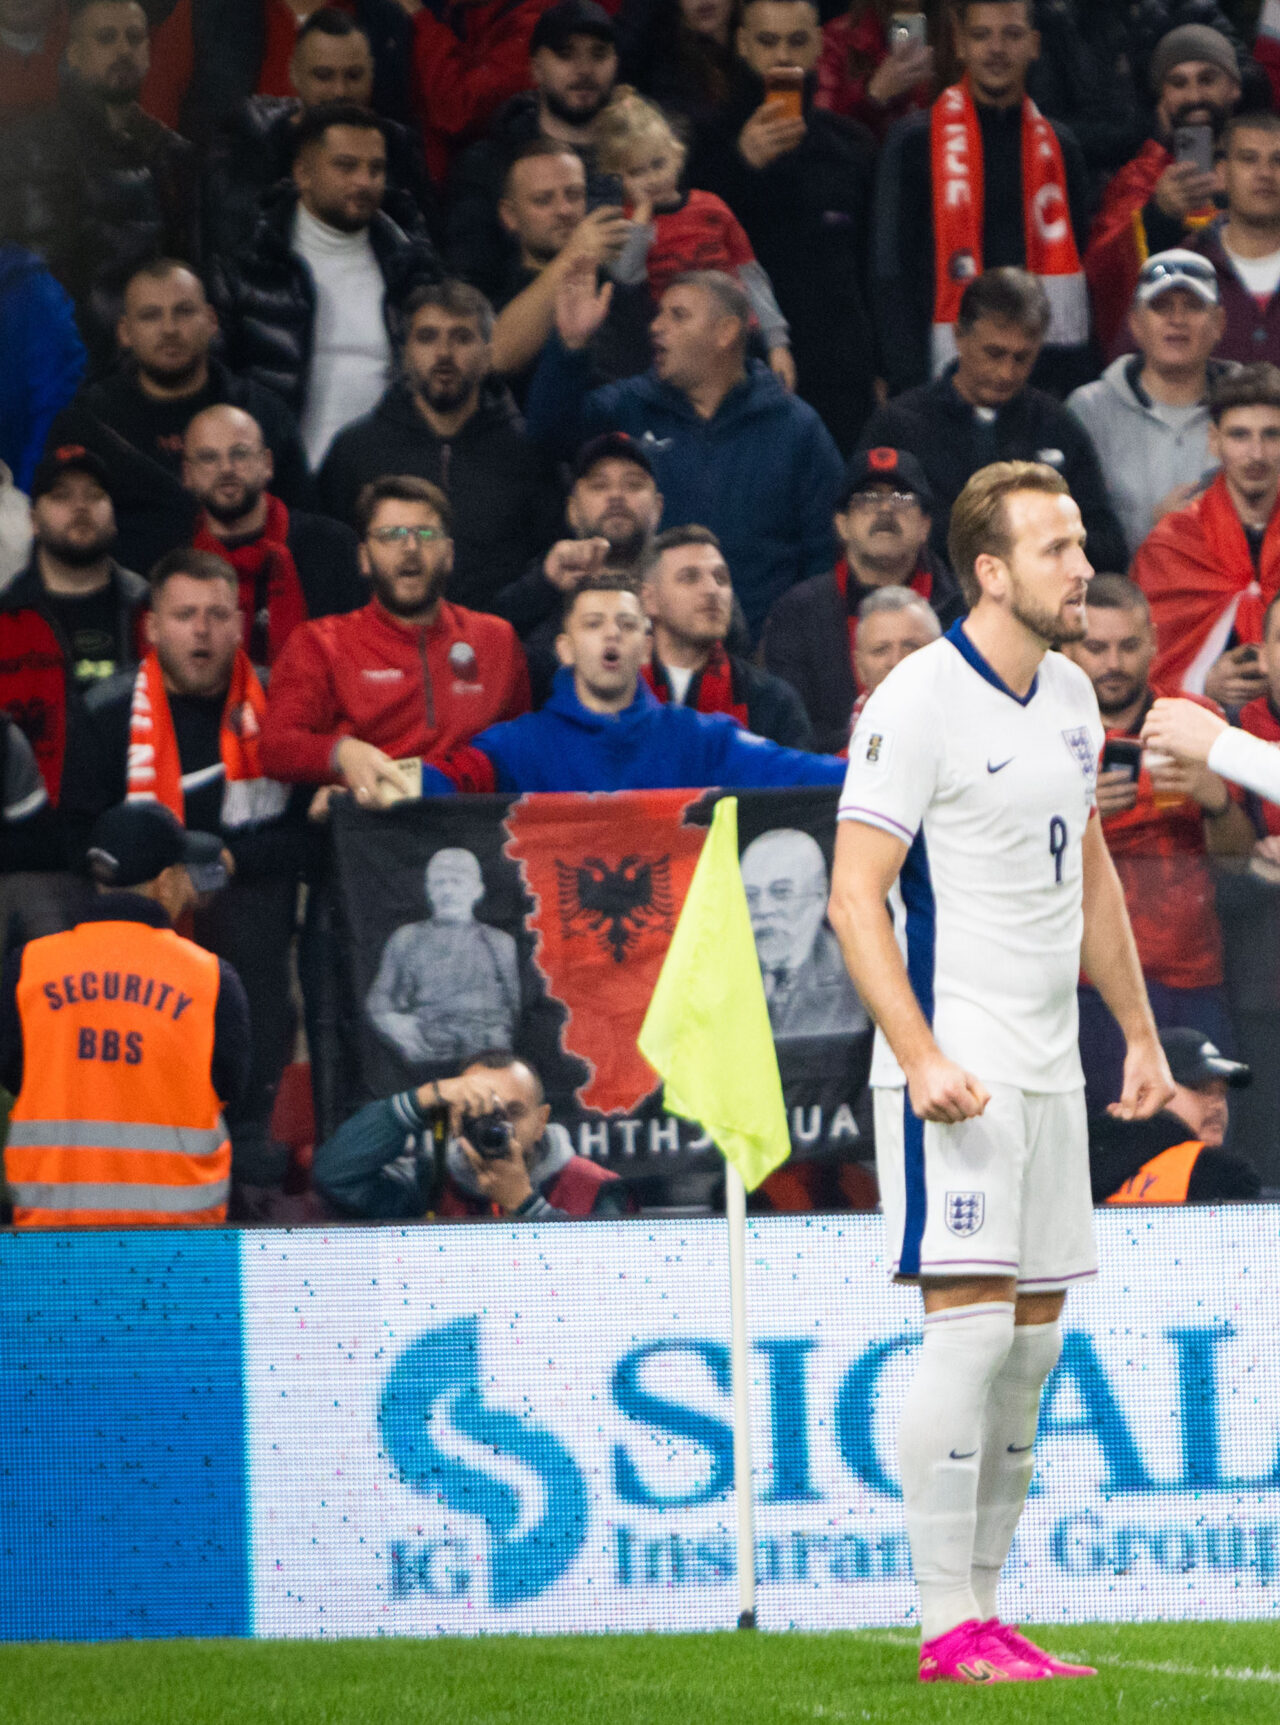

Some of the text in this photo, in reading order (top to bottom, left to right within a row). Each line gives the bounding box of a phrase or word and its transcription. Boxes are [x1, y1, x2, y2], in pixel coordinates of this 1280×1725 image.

[1050, 814, 1067, 885] 9
[43, 971, 193, 1021] SECURITY
[77, 1027, 144, 1066] BBS
[615, 1526, 1019, 1588] Insuran
